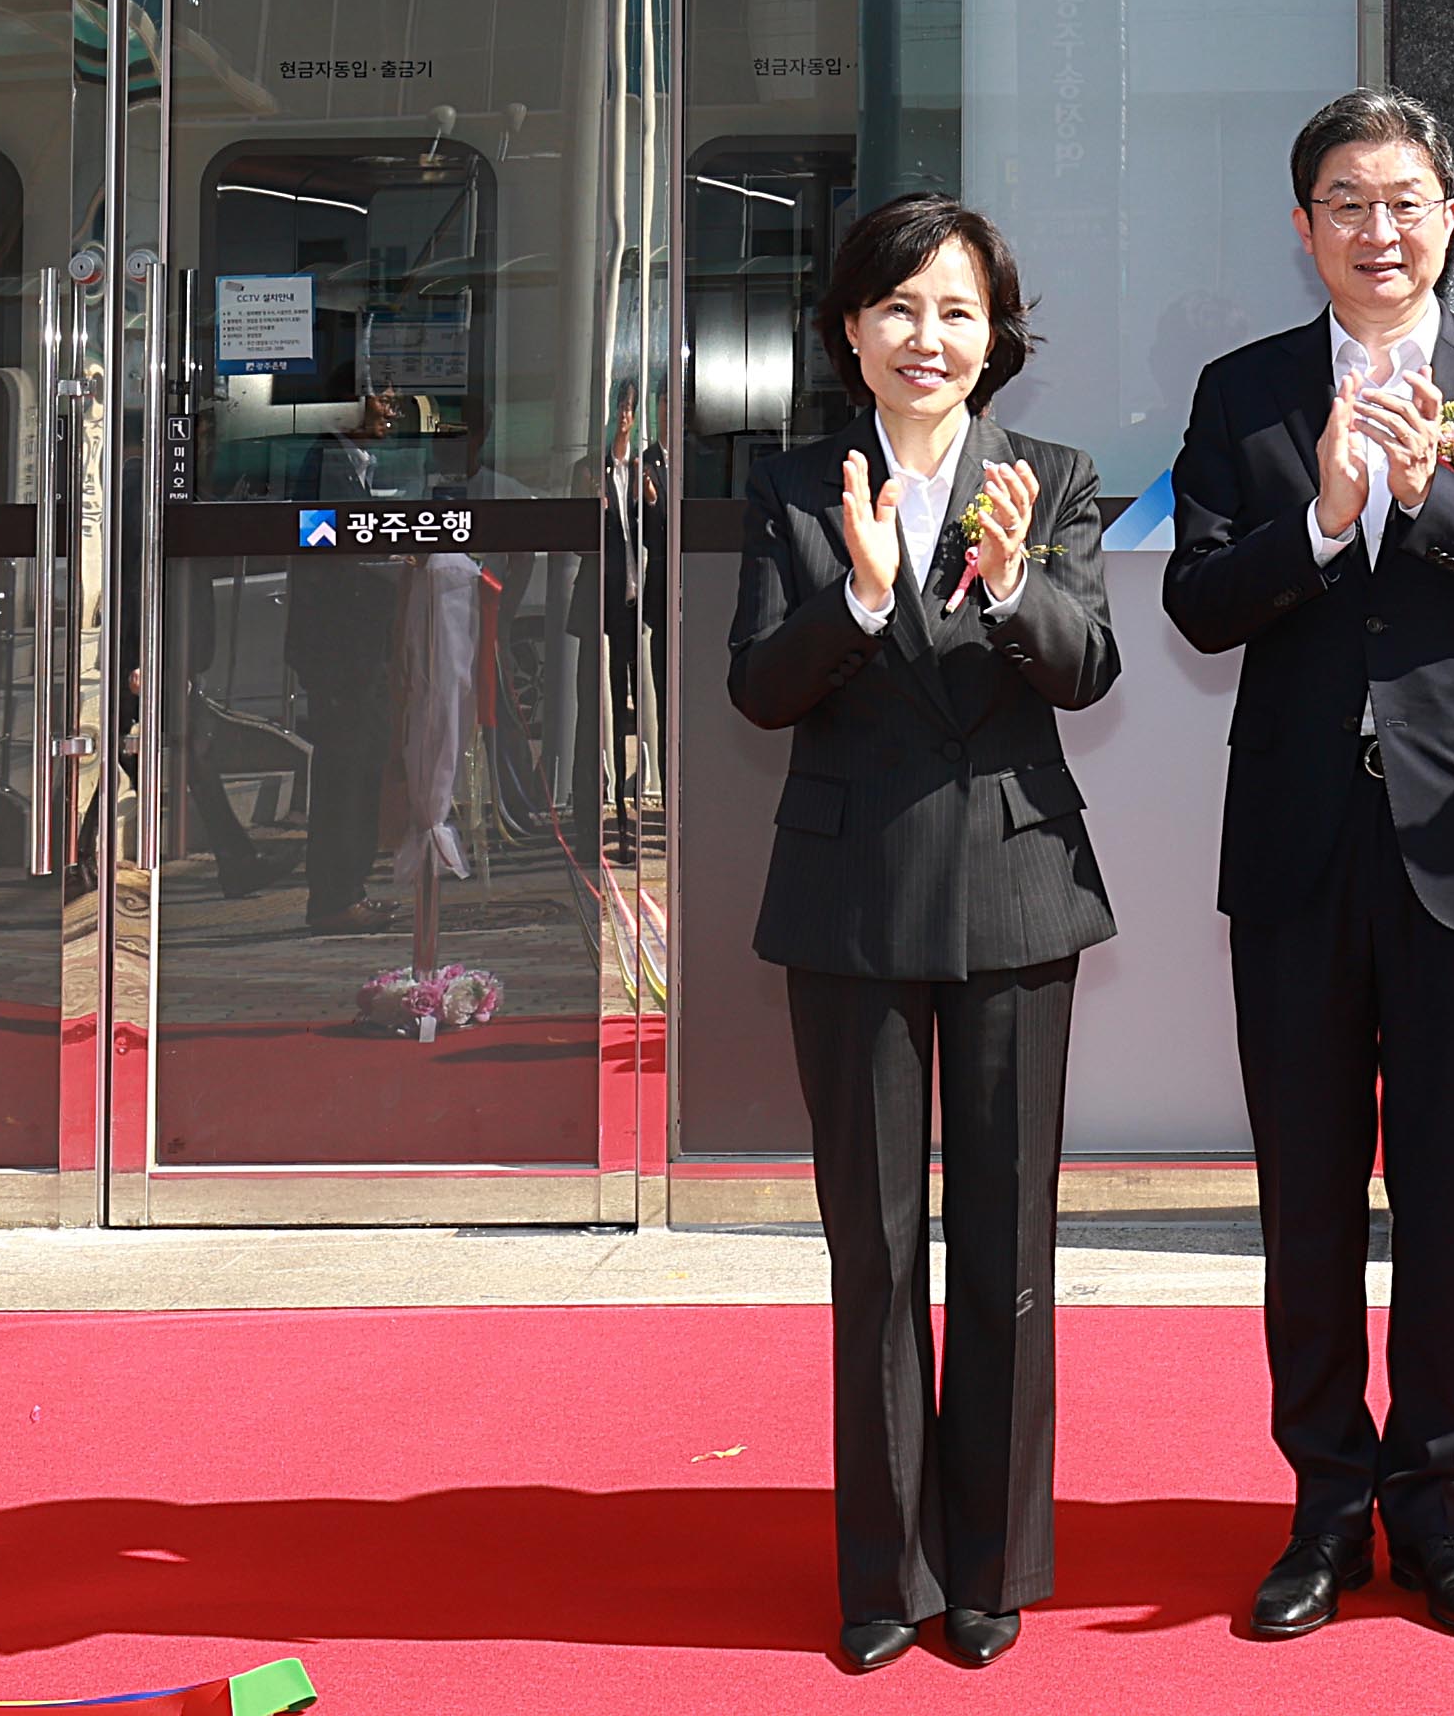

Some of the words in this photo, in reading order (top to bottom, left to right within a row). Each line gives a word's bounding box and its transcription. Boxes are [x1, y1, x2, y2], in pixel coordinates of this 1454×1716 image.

[236, 293, 260, 303] CCTV
[172, 445, 186, 489] 미시오
[169, 492, 189, 500] PUSH
[347, 510, 472, 543] 광주은행
